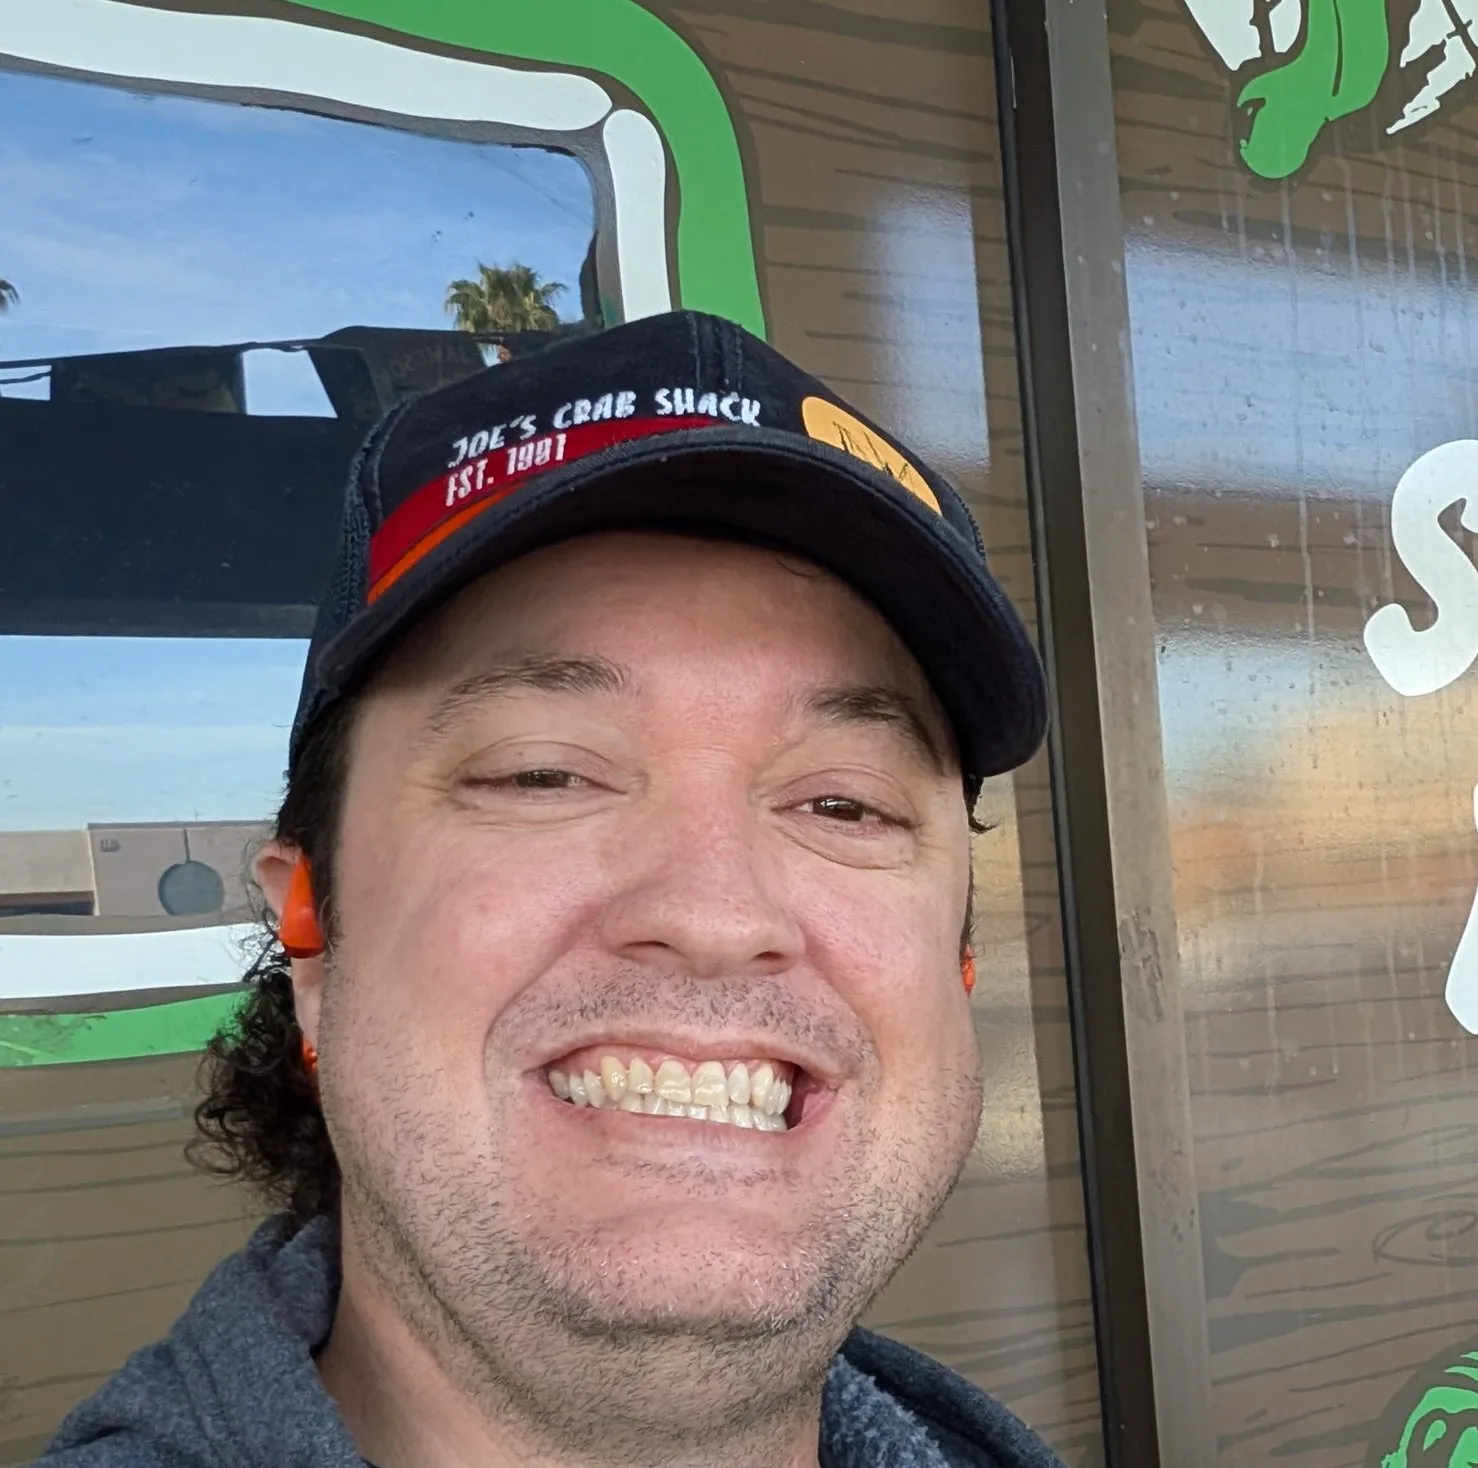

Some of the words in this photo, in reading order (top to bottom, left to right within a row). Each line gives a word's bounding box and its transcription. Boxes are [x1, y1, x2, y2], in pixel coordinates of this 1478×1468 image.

[447, 415, 536, 468] JOE'S
[553, 391, 636, 430] CRAB
[654, 388, 762, 428] SHACK
[445, 459, 494, 506] EST.
[506, 434, 567, 475] 1991
